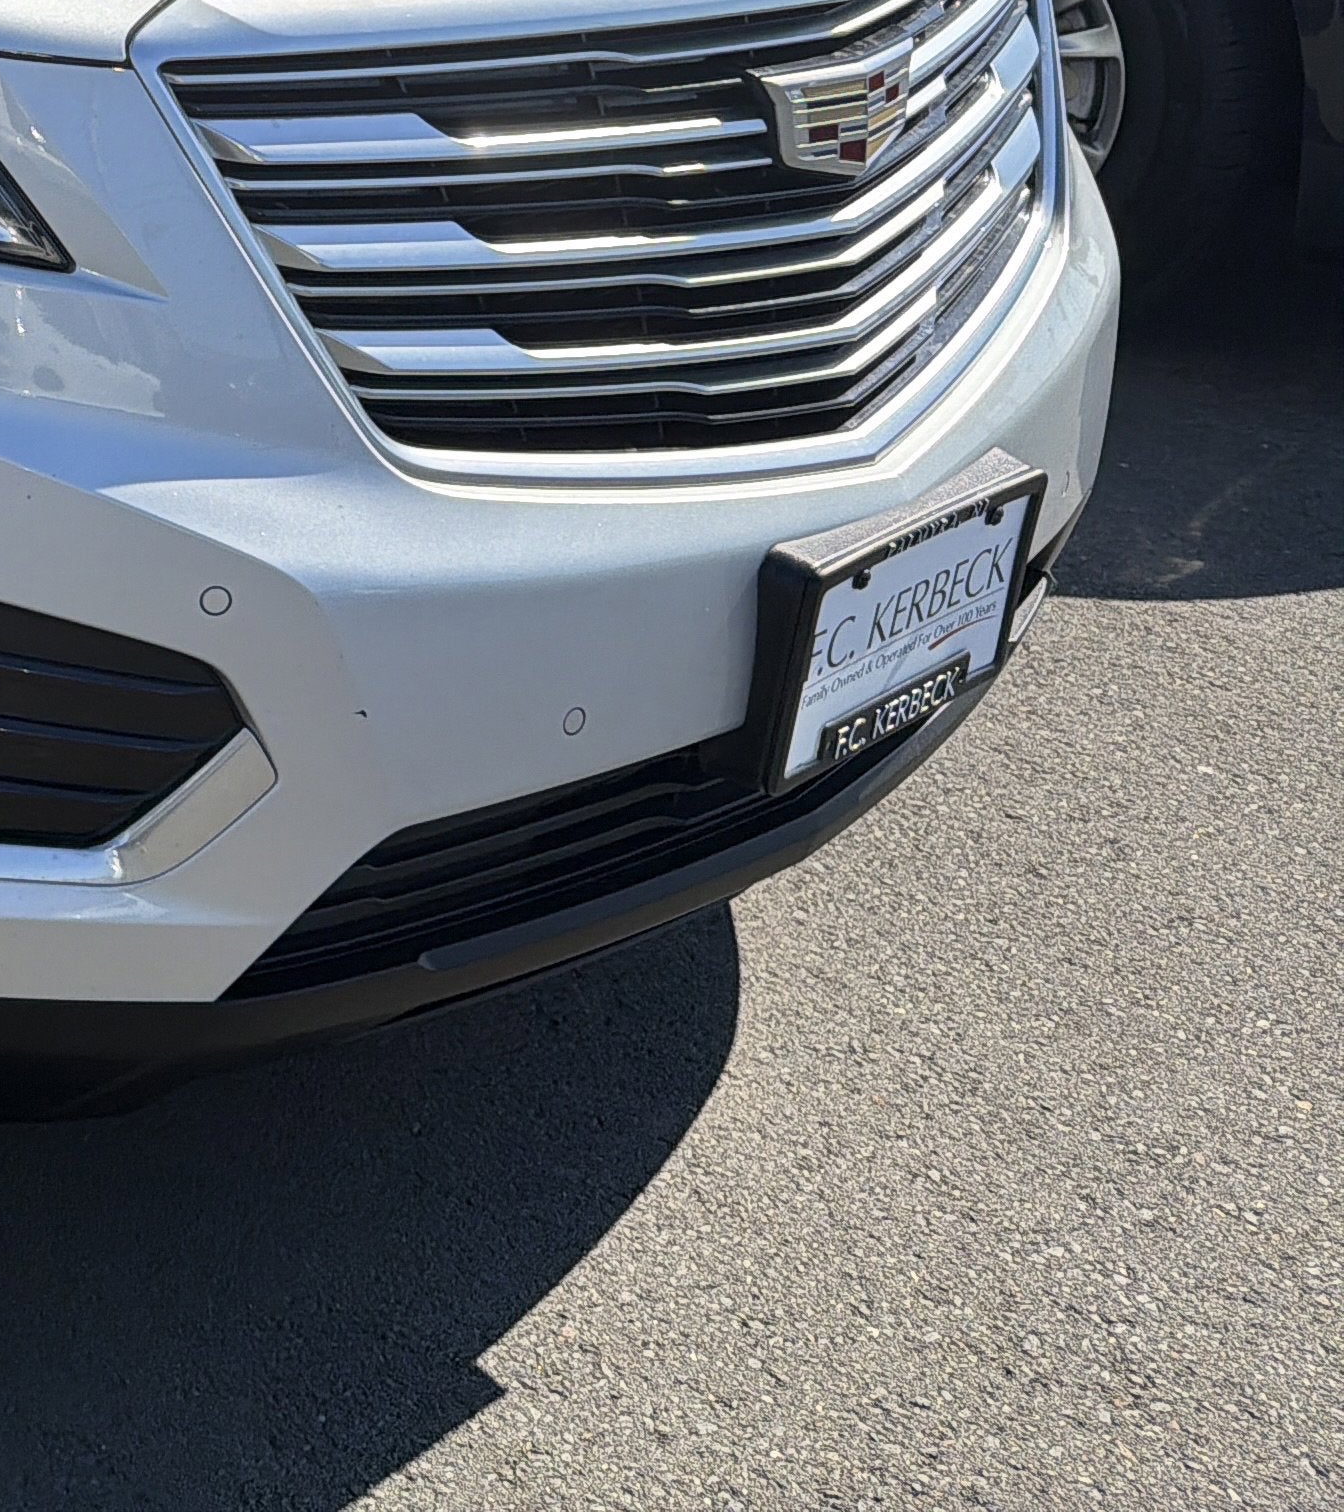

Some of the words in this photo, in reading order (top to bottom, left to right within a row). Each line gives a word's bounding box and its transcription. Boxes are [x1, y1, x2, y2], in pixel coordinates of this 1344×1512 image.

[867, 537, 1013, 650] KERBECK
[801, 686, 829, 710] Family
[831, 664, 864, 693] Owned
[864, 662, 874, 676] &
[874, 635, 919, 672] Operated
[916, 631, 933, 648] For
[933, 620, 957, 639] Over
[957, 613, 974, 627] 100
[975, 600, 998, 619] Years
[835, 717, 867, 761] F.C.
[873, 666, 960, 740] KERBECK
